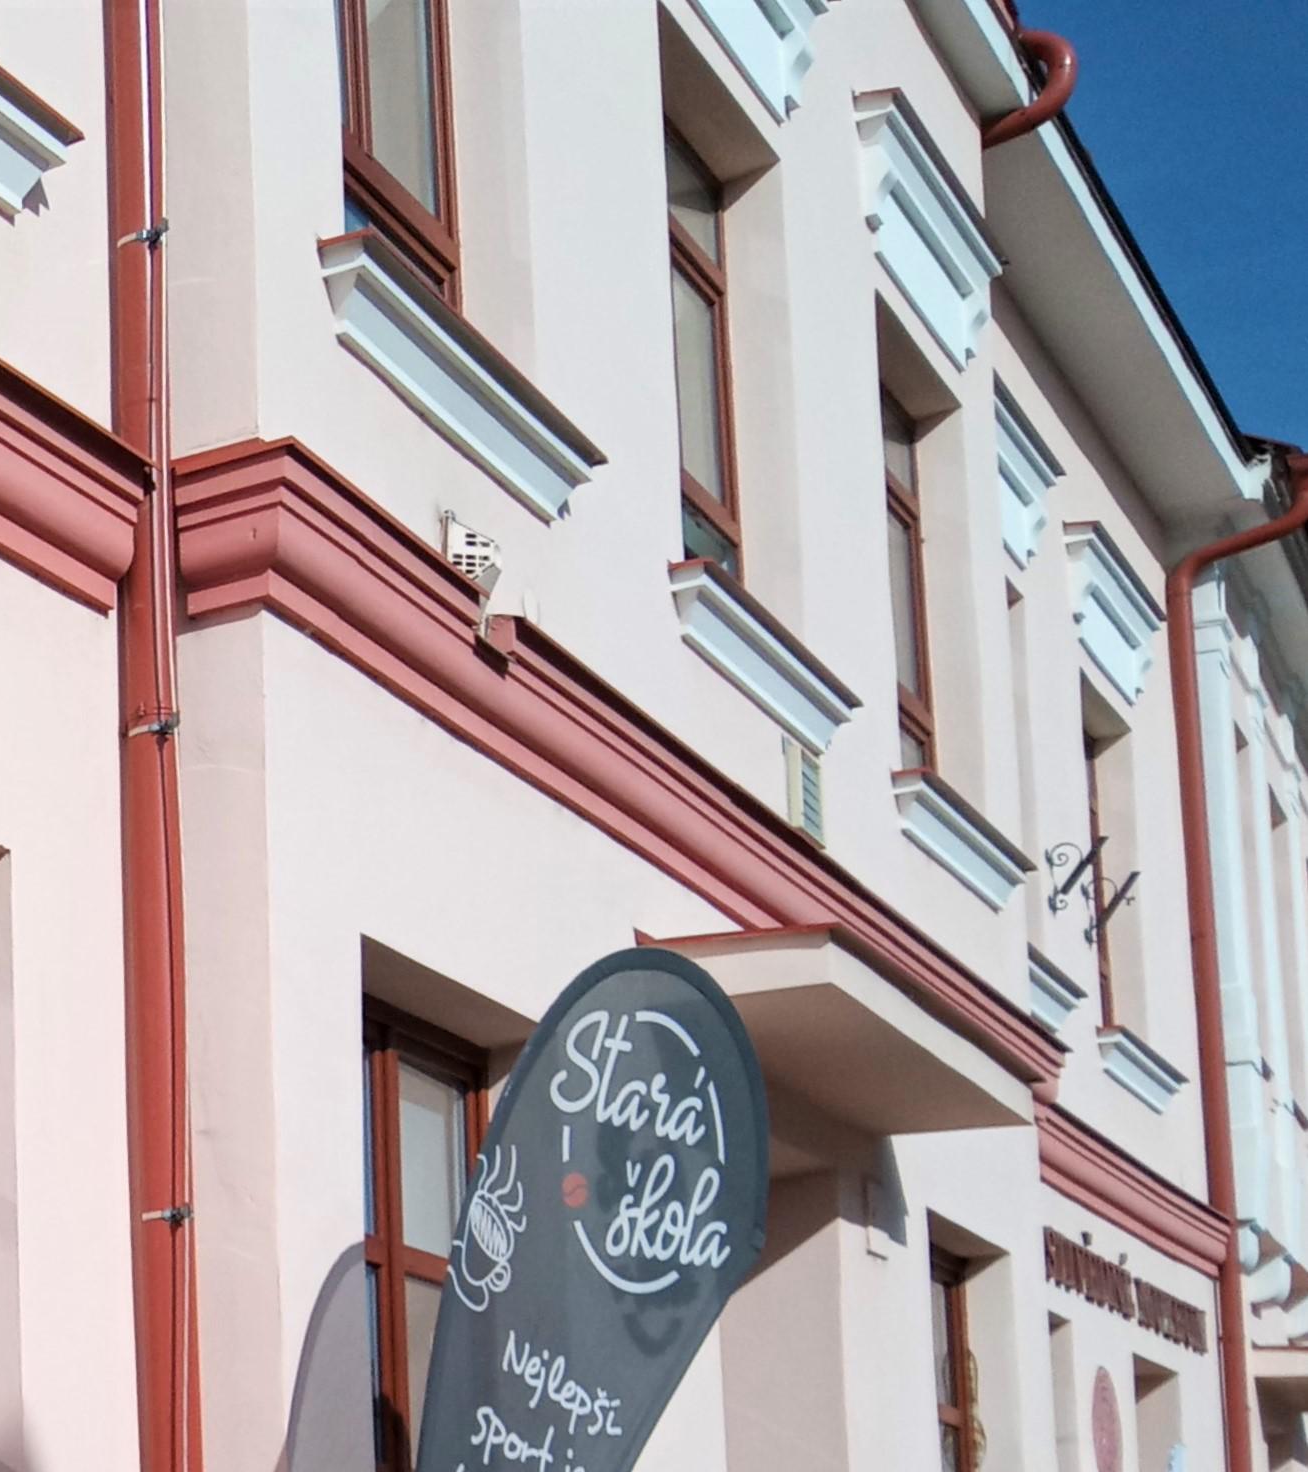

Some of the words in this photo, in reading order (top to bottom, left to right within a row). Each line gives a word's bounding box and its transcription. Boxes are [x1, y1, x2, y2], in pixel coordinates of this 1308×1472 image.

[550, 1010, 706, 1146] Stará
[605, 1154, 731, 1269] škola
[502, 1330, 622, 1436] Nejlepší
